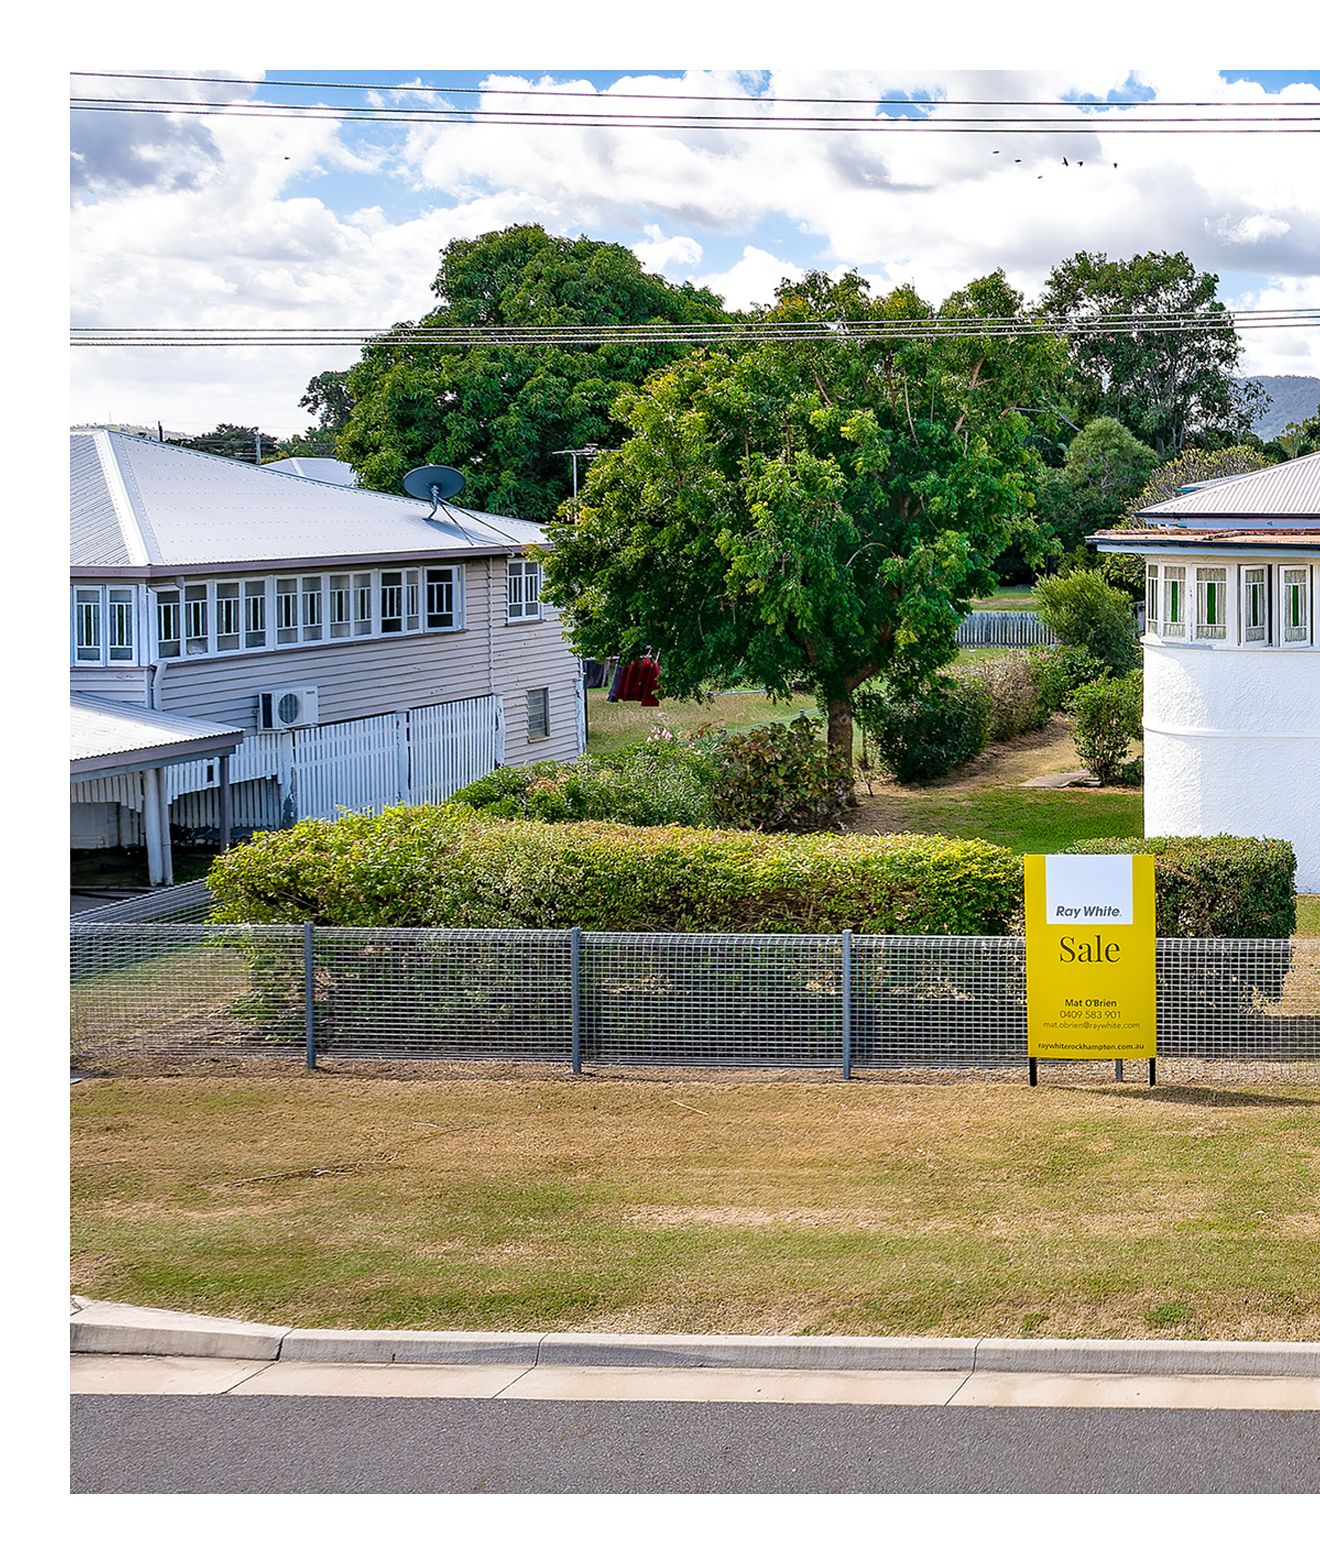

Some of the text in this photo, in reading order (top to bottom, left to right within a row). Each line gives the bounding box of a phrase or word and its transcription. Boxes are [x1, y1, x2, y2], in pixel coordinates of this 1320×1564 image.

[1055, 905, 1121, 918] Ray White
[1060, 935, 1121, 963] Sale
[1065, 998, 1117, 1007] Mat O'Brien
[1060, 1010, 1121, 1019] 0409 583 901
[1043, 1021, 1140, 1029] mat.obrien@raywhite.com
[1038, 1043, 1144, 1051] raywhiterockhampton.com.au
